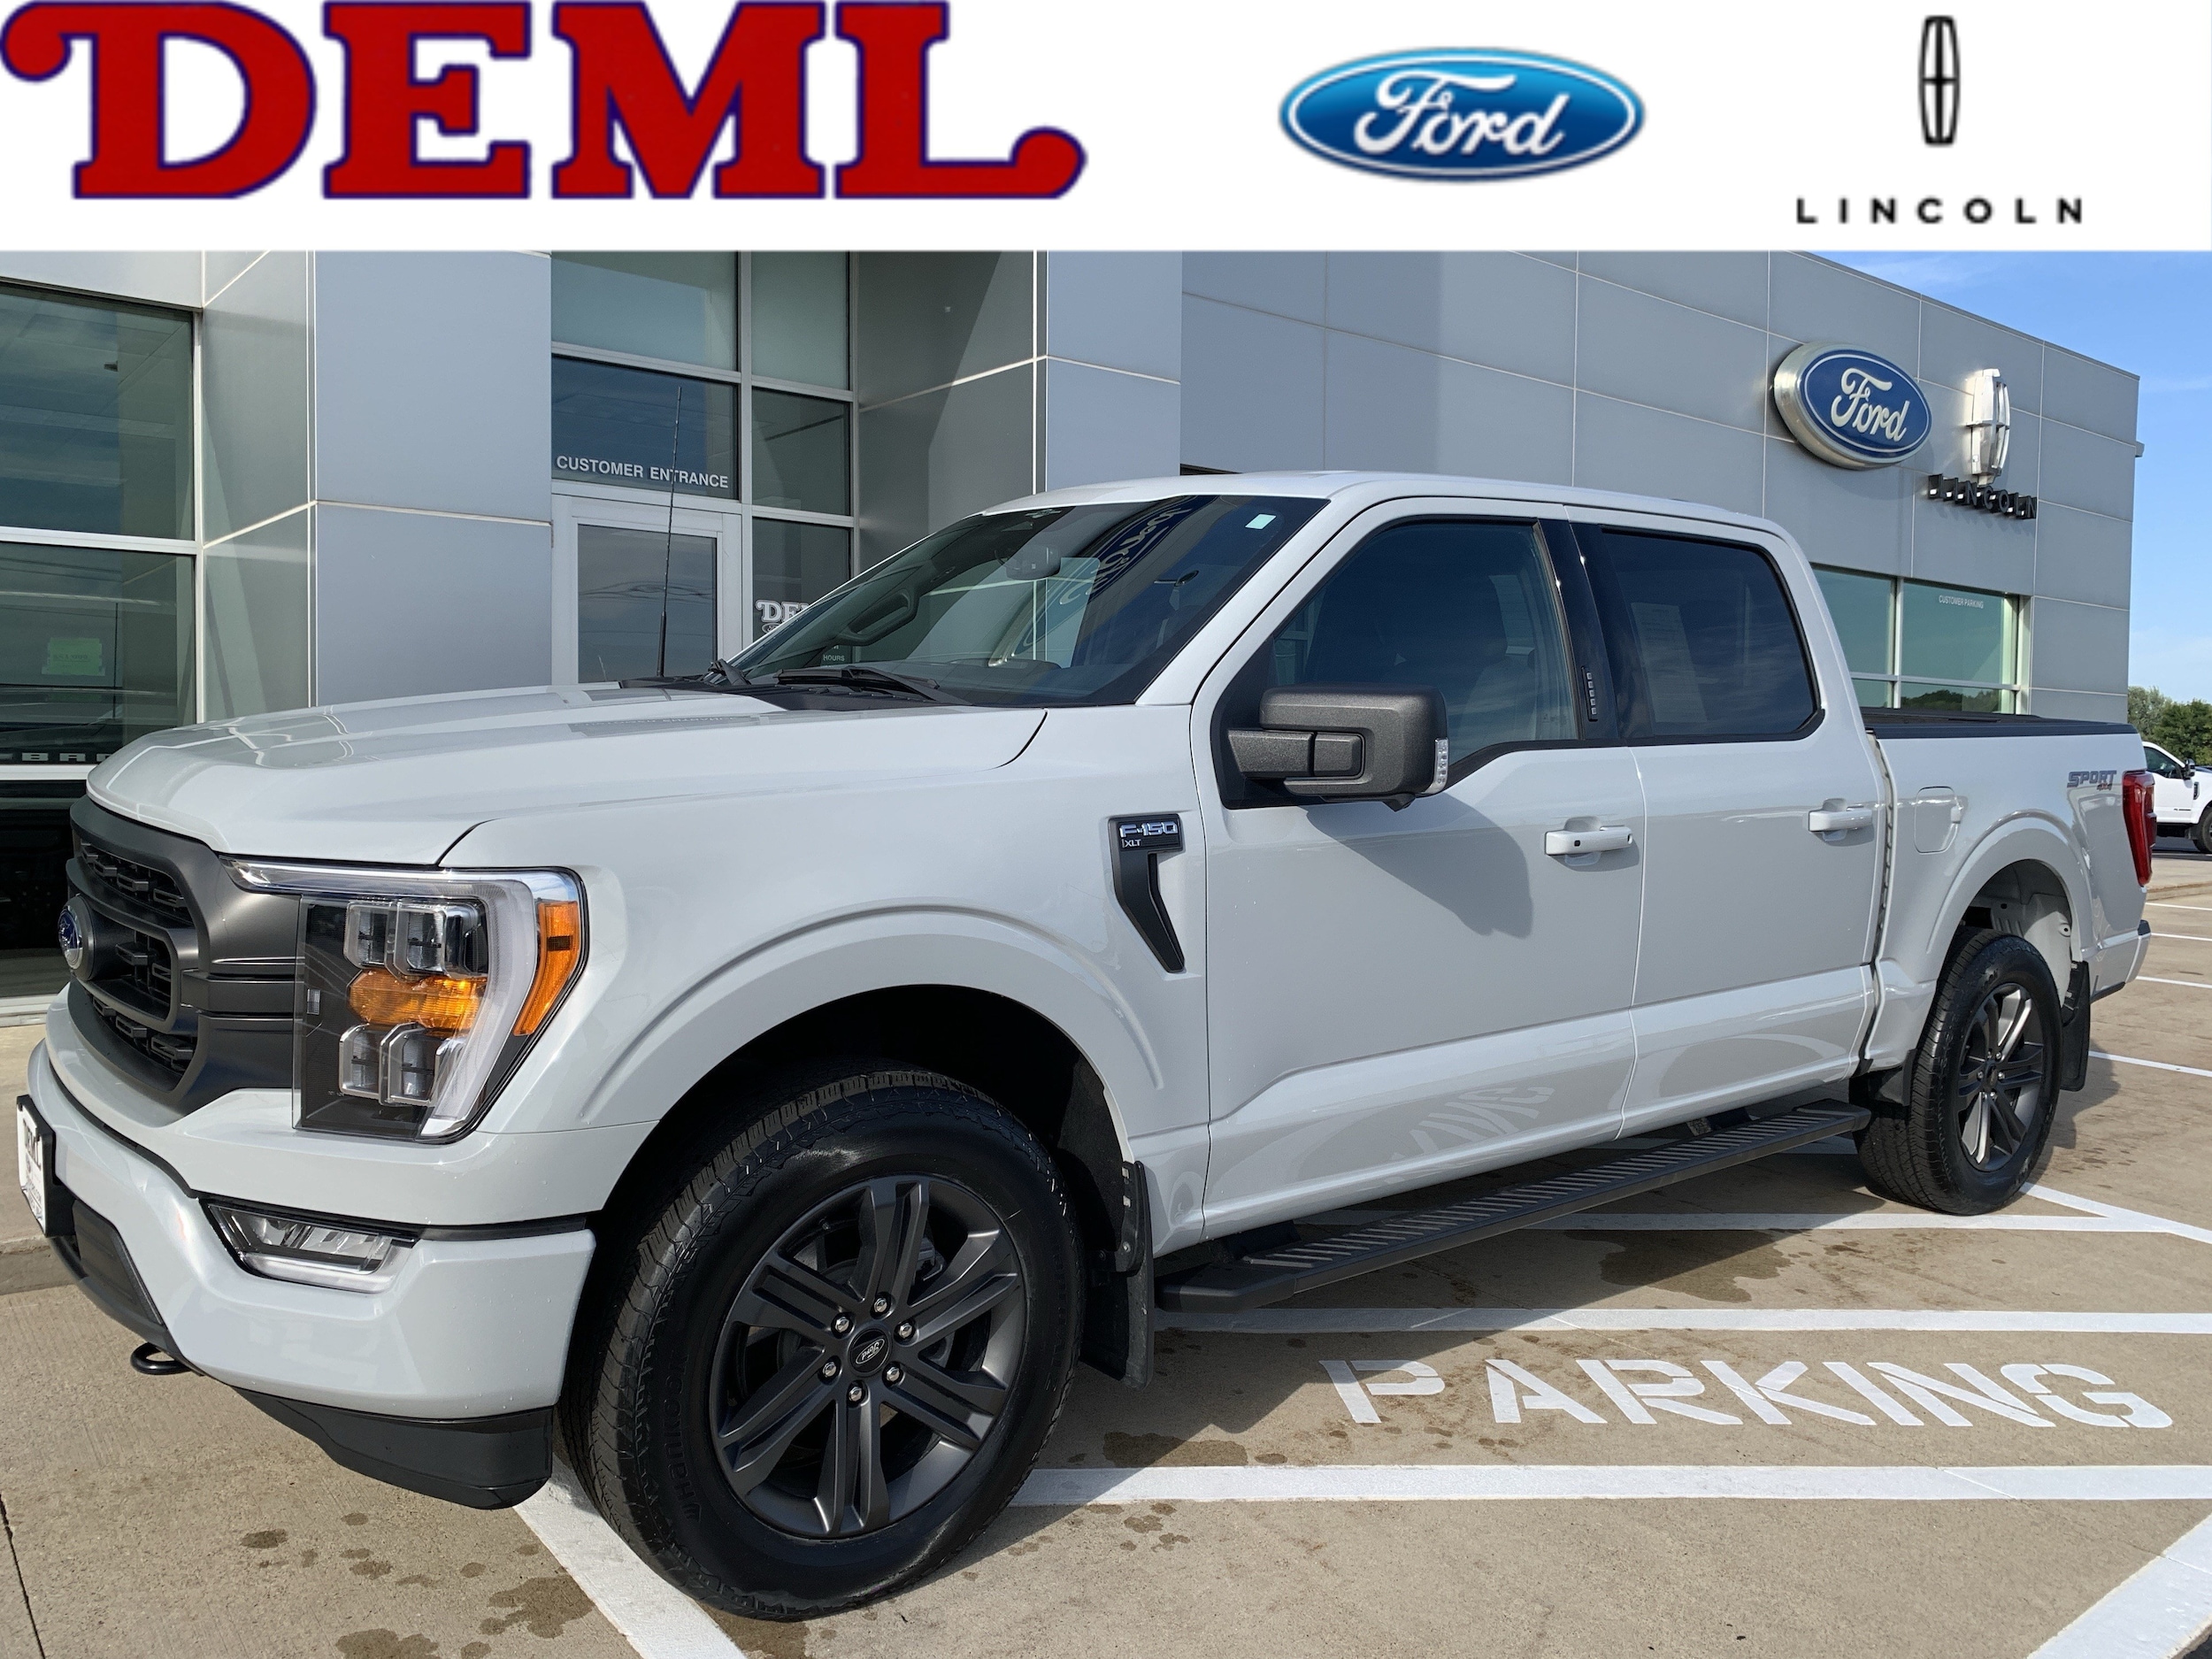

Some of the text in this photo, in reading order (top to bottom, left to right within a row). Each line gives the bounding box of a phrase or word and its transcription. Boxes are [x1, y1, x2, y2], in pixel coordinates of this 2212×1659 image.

[1831, 367, 1910, 442] Ford
[556, 455, 729, 488] CUSTOMER ENTRANCE
[1929, 473, 2038, 519] LINCOLN
[2067, 770, 2117, 787] SPORT
[1119, 821, 1179, 838] F-150
[1125, 839, 1142, 848] XLT
[861, 1341, 880, 1361] Ford
[1318, 1358, 2175, 1429] PARKING
